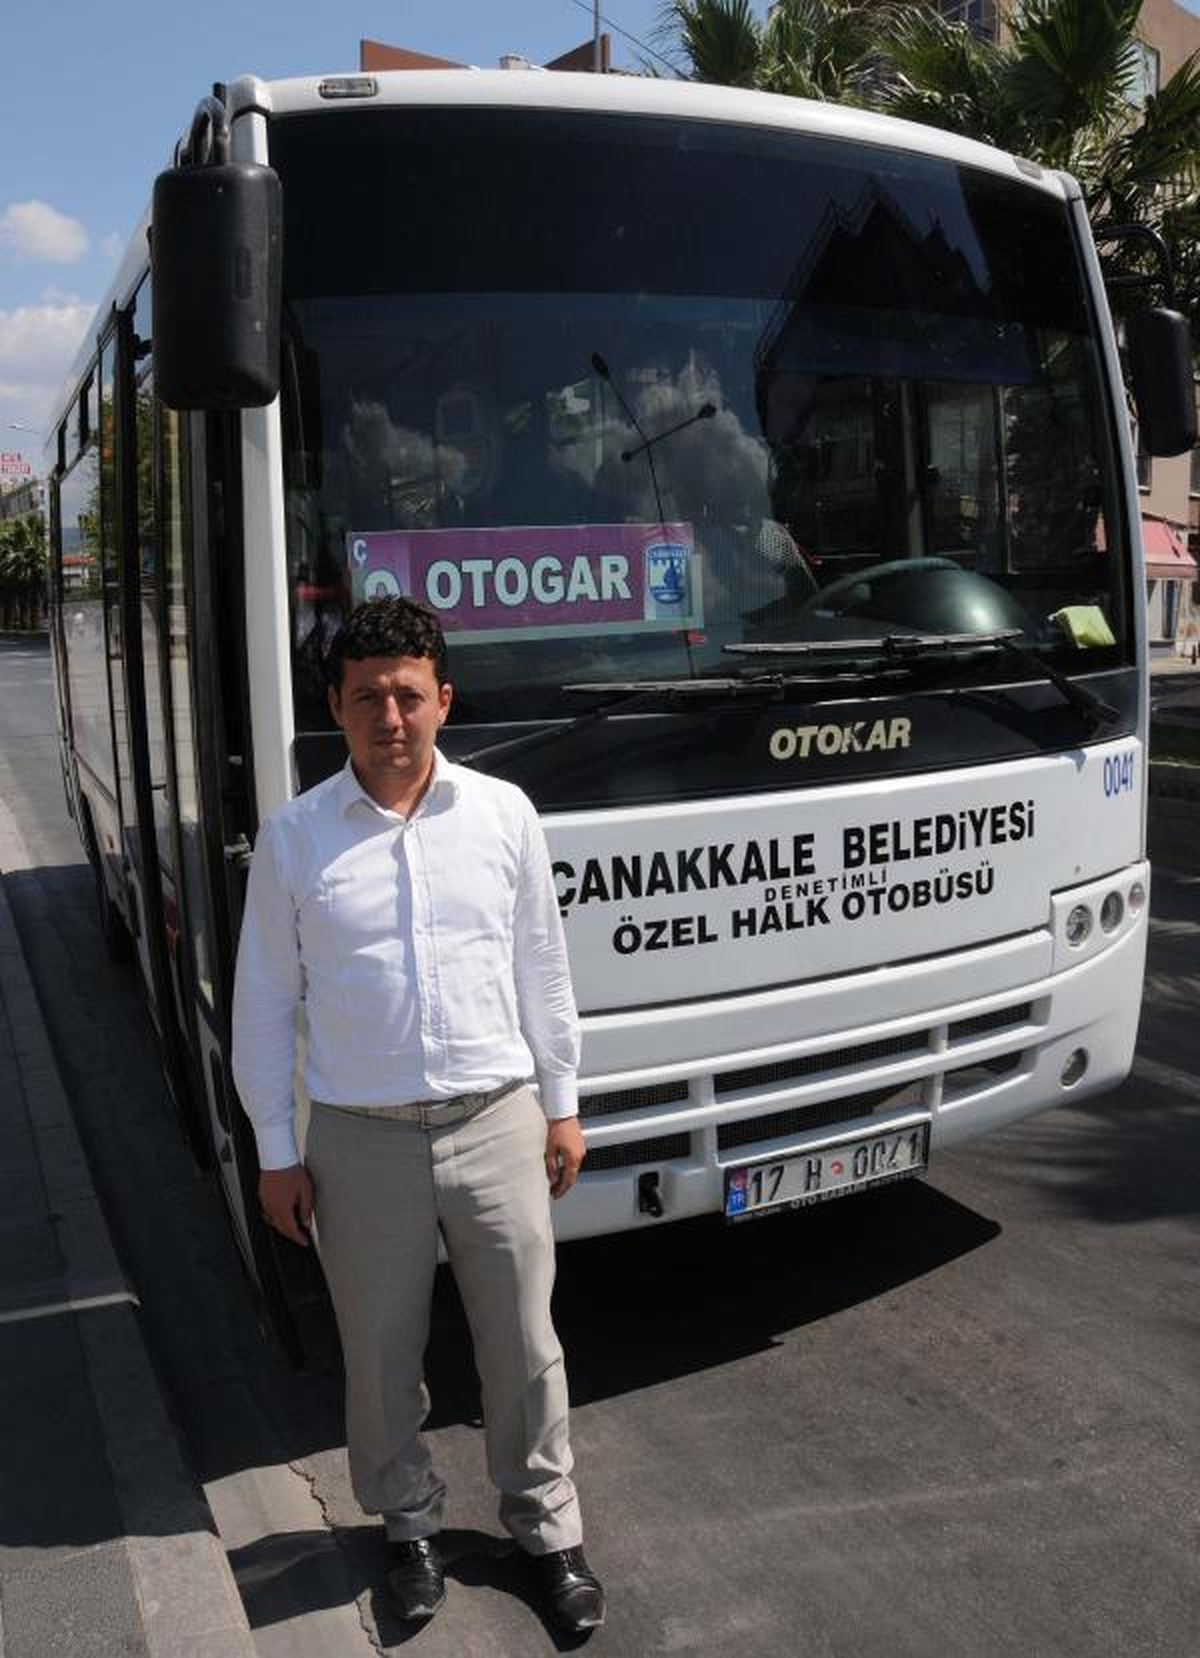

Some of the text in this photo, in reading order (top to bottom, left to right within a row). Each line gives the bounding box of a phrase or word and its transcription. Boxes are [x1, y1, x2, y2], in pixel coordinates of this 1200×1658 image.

[425, 555, 633, 609] OTOGAR
[769, 717, 912, 760] OTOKAR
[1103, 752, 1135, 798] 0041
[551, 833, 816, 918] ÇANAKKALE
[612, 860, 995, 955] ÖZEL HALK OTOBÜSÜ
[751, 1164, 785, 1206] 17
[804, 1158, 823, 1193] H
